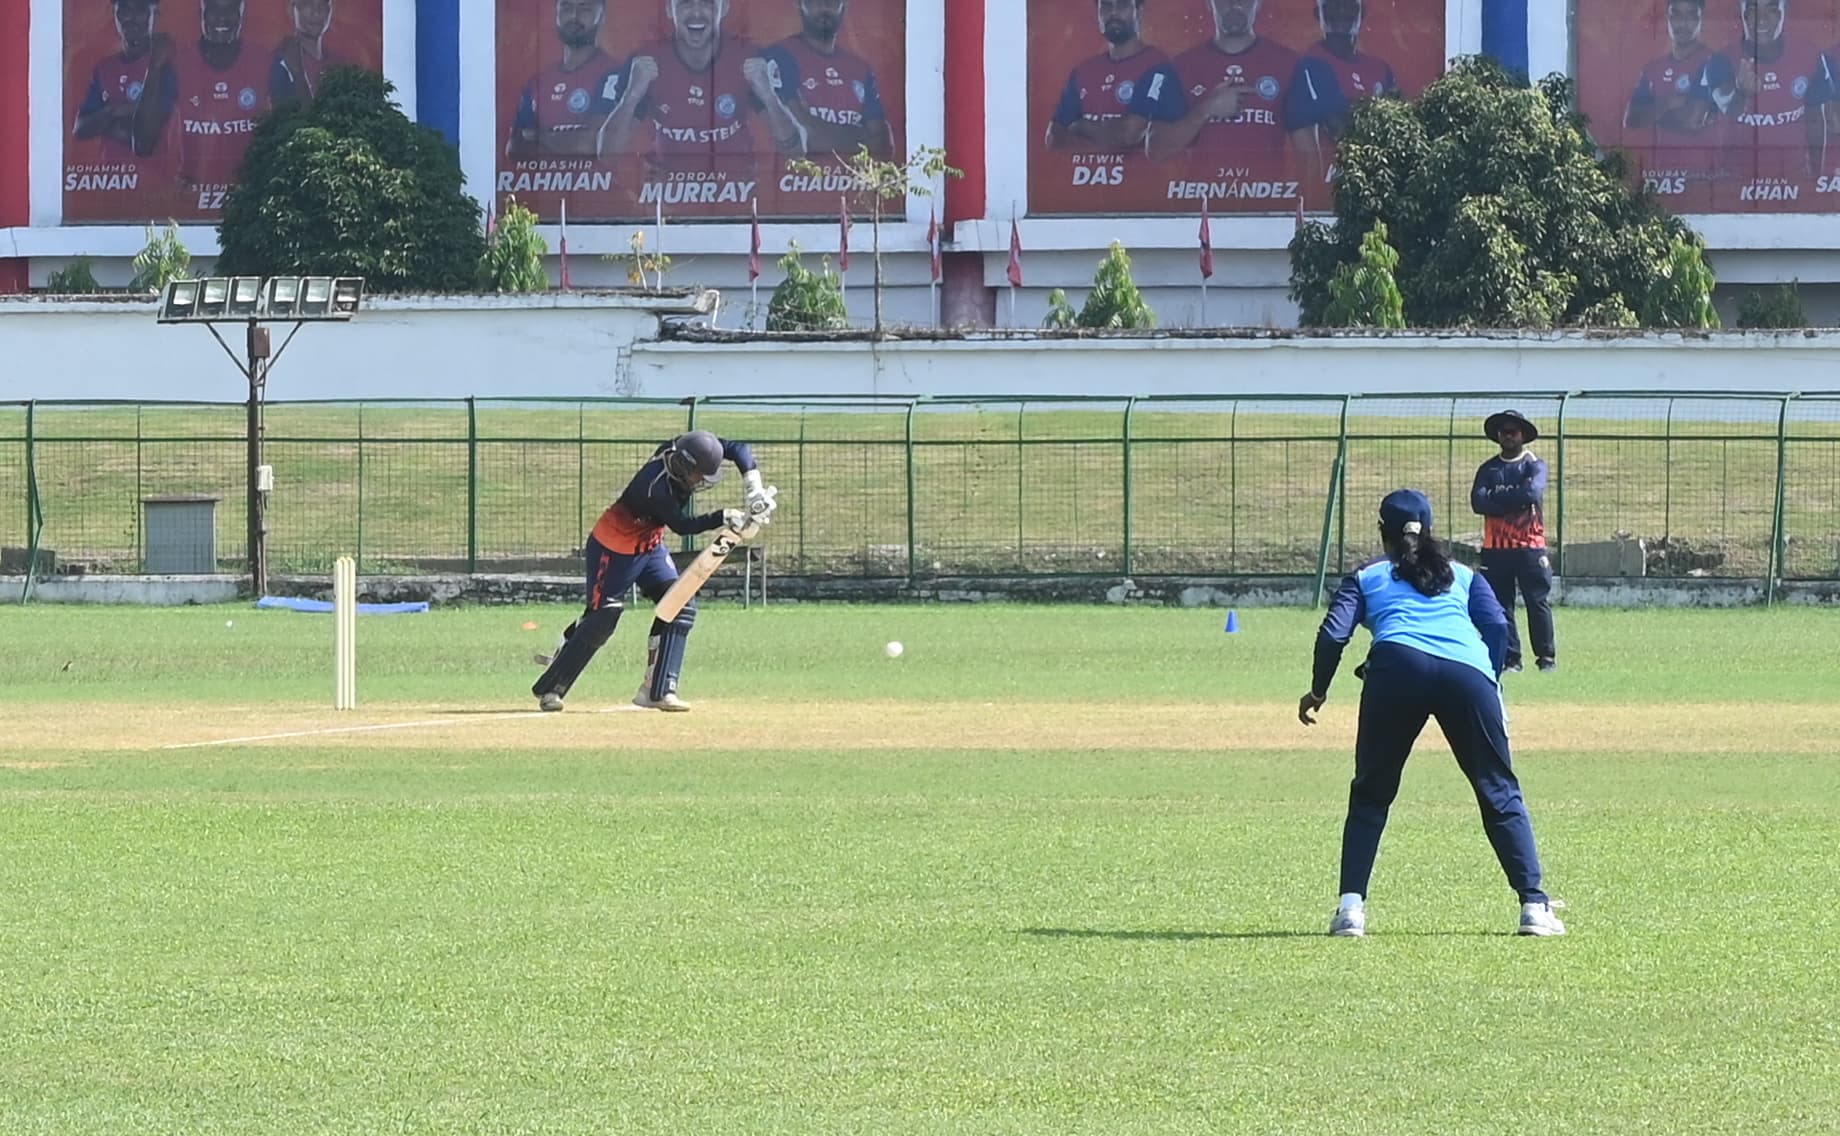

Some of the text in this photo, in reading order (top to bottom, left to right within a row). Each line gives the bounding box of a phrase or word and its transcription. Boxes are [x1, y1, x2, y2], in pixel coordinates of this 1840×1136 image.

[184, 120, 254, 134] TATA STE
[516, 161, 593, 170] MOBASHIR
[1072, 155, 1124, 163] RITWIK
[66, 164, 136, 172] MOHAMMED
[1072, 166, 1124, 185] DAS
[1217, 168, 1249, 177] JAVI
[64, 173, 138, 190] SANAN
[497, 171, 612, 191] RAHMAN
[668, 172, 727, 181] JORDAN
[780, 174, 878, 192] CHAUDH
[1816, 176, 1840, 192] SA
[191, 184, 234, 192] STEPH
[639, 182, 755, 203] MURRAY
[1167, 179, 1299, 199] HERNÁNDEZ
[1741, 186, 1799, 200] KHAN
[198, 192, 228, 209] EZ
